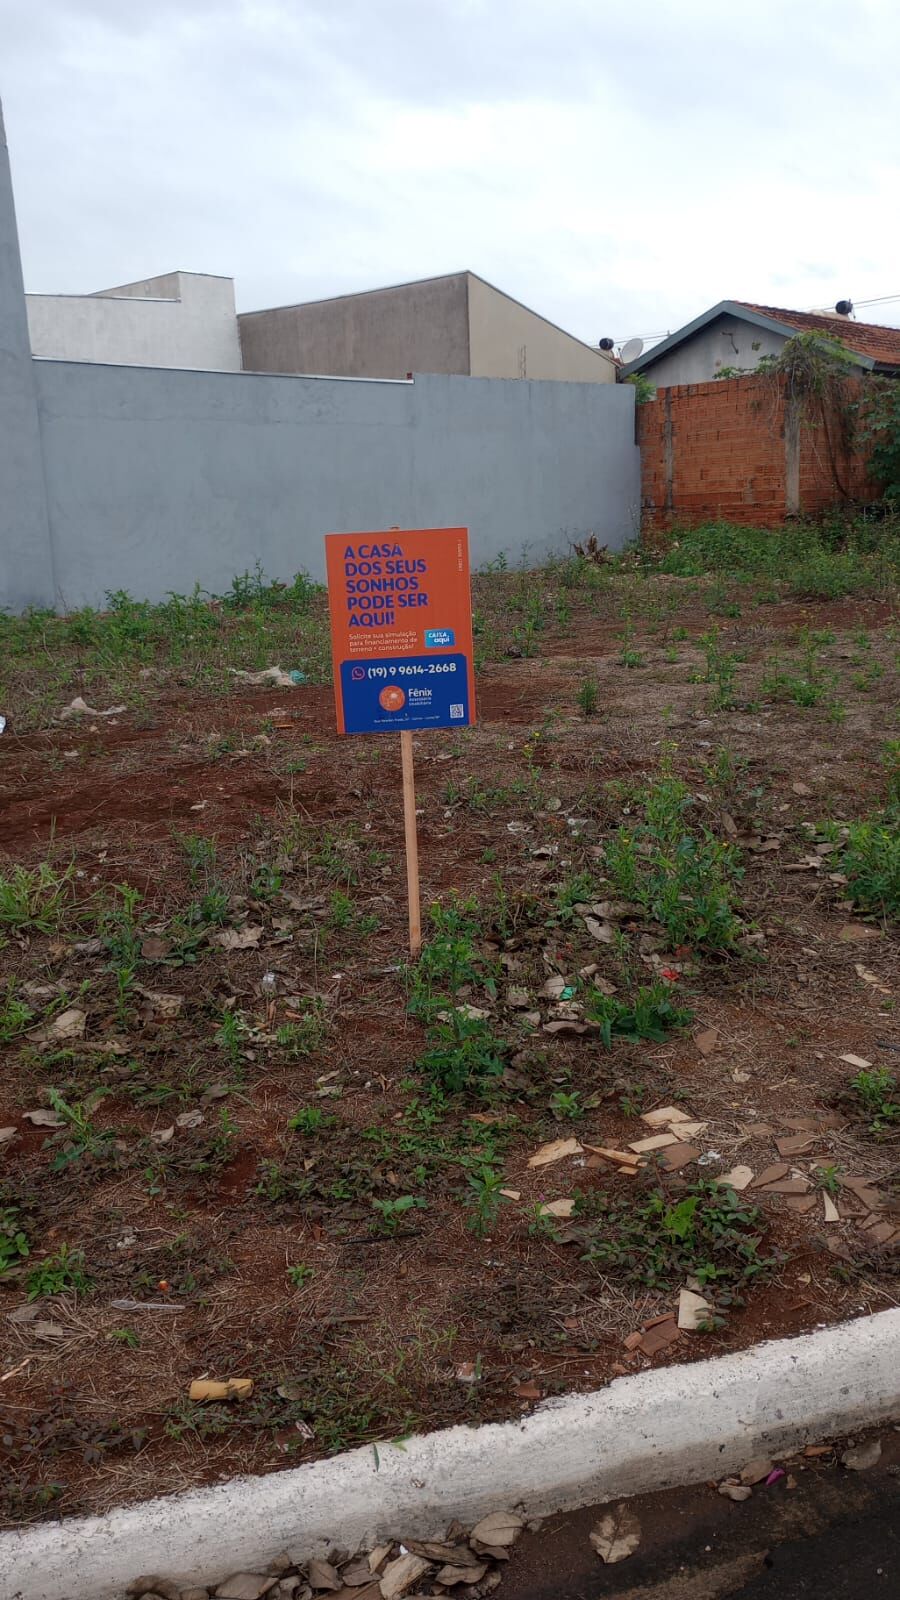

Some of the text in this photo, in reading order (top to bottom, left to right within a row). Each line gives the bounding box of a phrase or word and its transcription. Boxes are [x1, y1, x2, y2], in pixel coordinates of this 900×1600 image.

[344, 544, 403, 560] A CASA
[345, 559, 427, 577] DOS SEUS
[346, 576, 419, 593] SONHOS
[347, 593, 428, 610] PODE SER
[349, 612, 395, 627] AQUI!
[349, 632, 371, 640] Solicite
[349, 640, 364, 648] para
[364, 638, 407, 646] financiamento
[368, 663, 457, 680] (19) 9 9614-2668
[408, 688, 433, 697] Fênix
